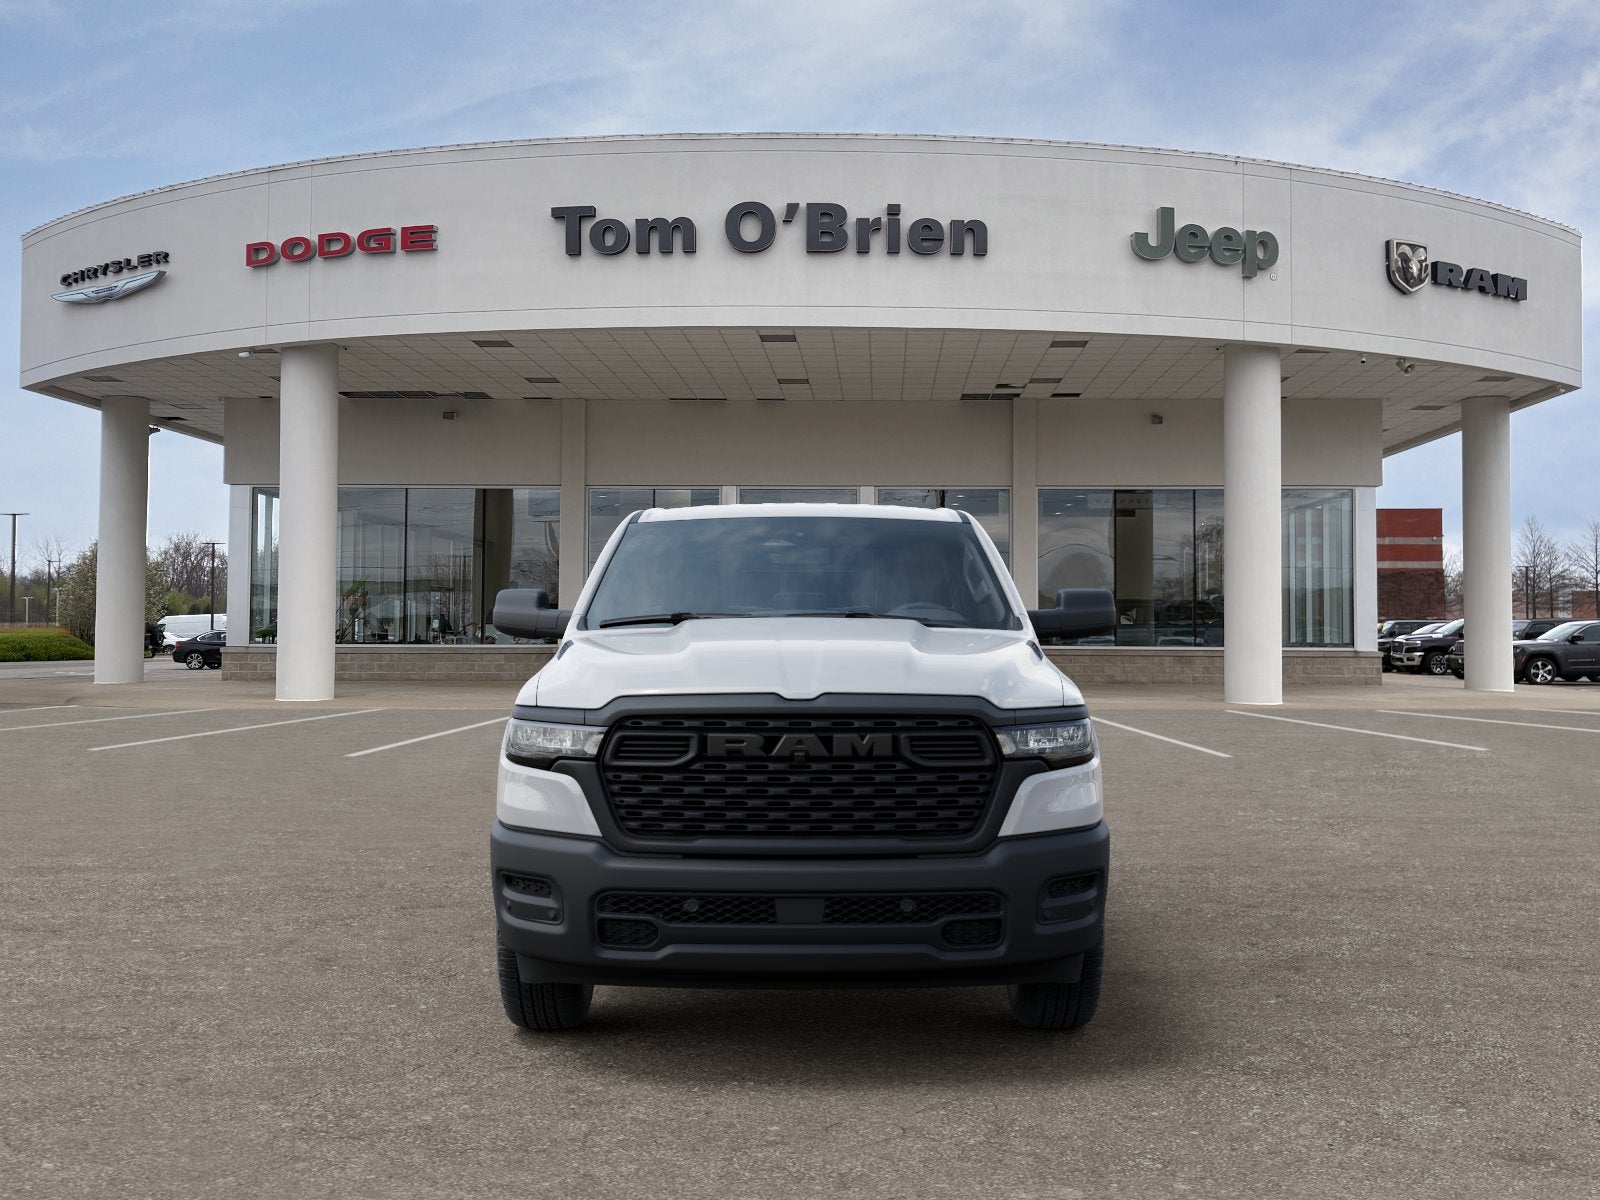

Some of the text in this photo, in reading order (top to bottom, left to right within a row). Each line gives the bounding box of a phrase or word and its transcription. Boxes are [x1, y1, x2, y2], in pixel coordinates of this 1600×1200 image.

[246, 224, 438, 269] DODGE
[551, 201, 988, 256] Tom O'Brien
[1131, 207, 1279, 278] Jeep
[60, 250, 170, 287] CHRYSLER
[1431, 260, 1528, 301] RAM
[706, 732, 895, 758] RAM
